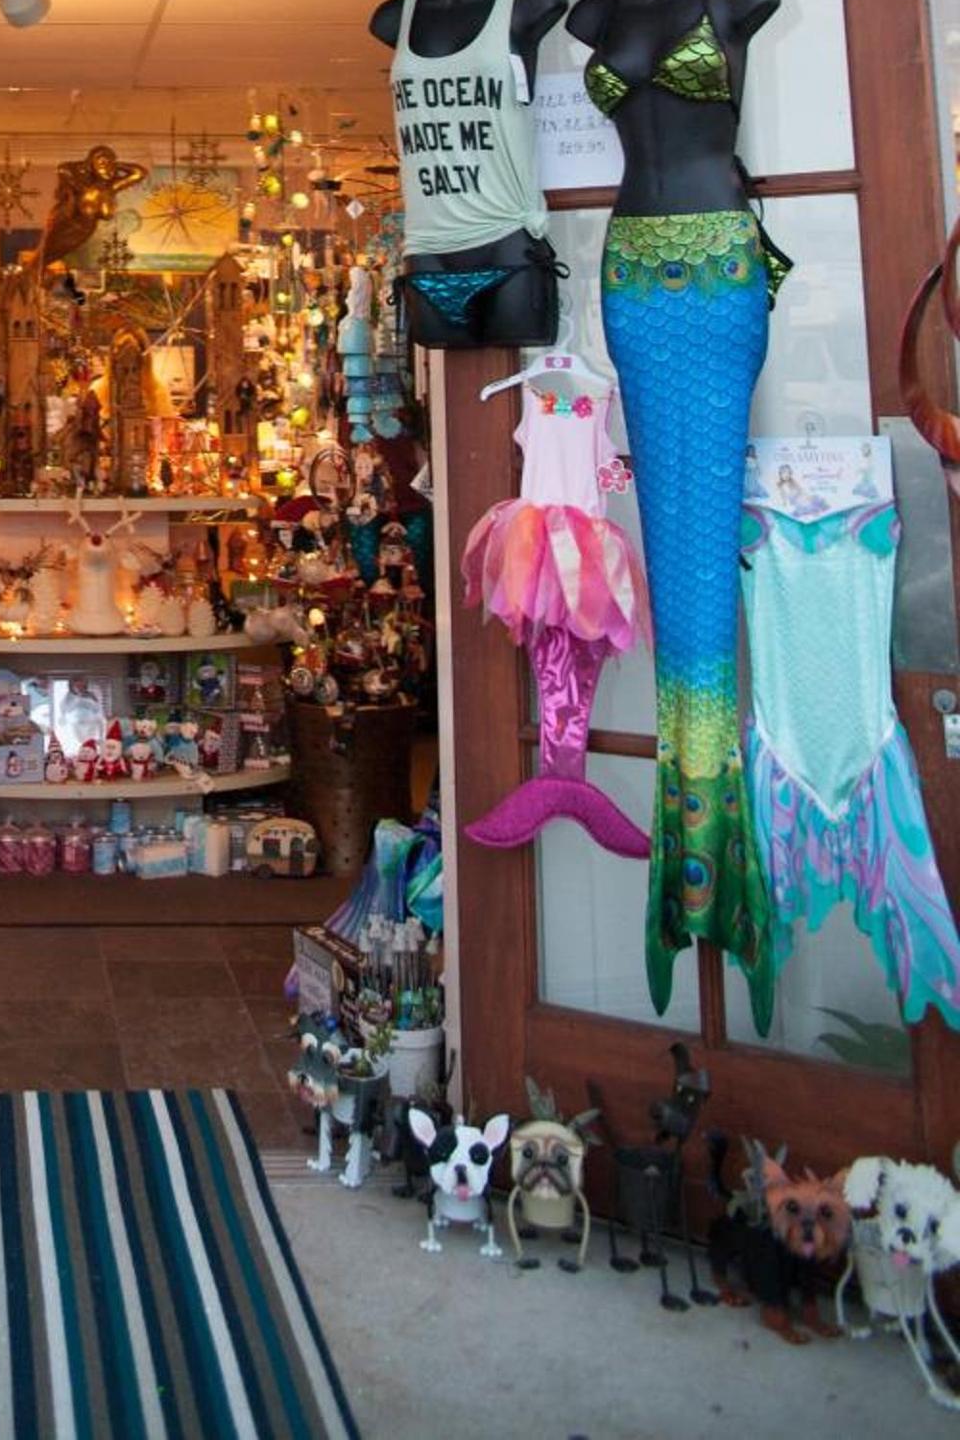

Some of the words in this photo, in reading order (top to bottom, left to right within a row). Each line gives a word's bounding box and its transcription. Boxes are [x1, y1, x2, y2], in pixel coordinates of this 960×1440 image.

[392, 78, 418, 112] HE
[423, 75, 503, 111] OCEAN
[399, 121, 453, 156] MADE
[460, 121, 494, 152] ME
[418, 163, 481, 198] SALTY
